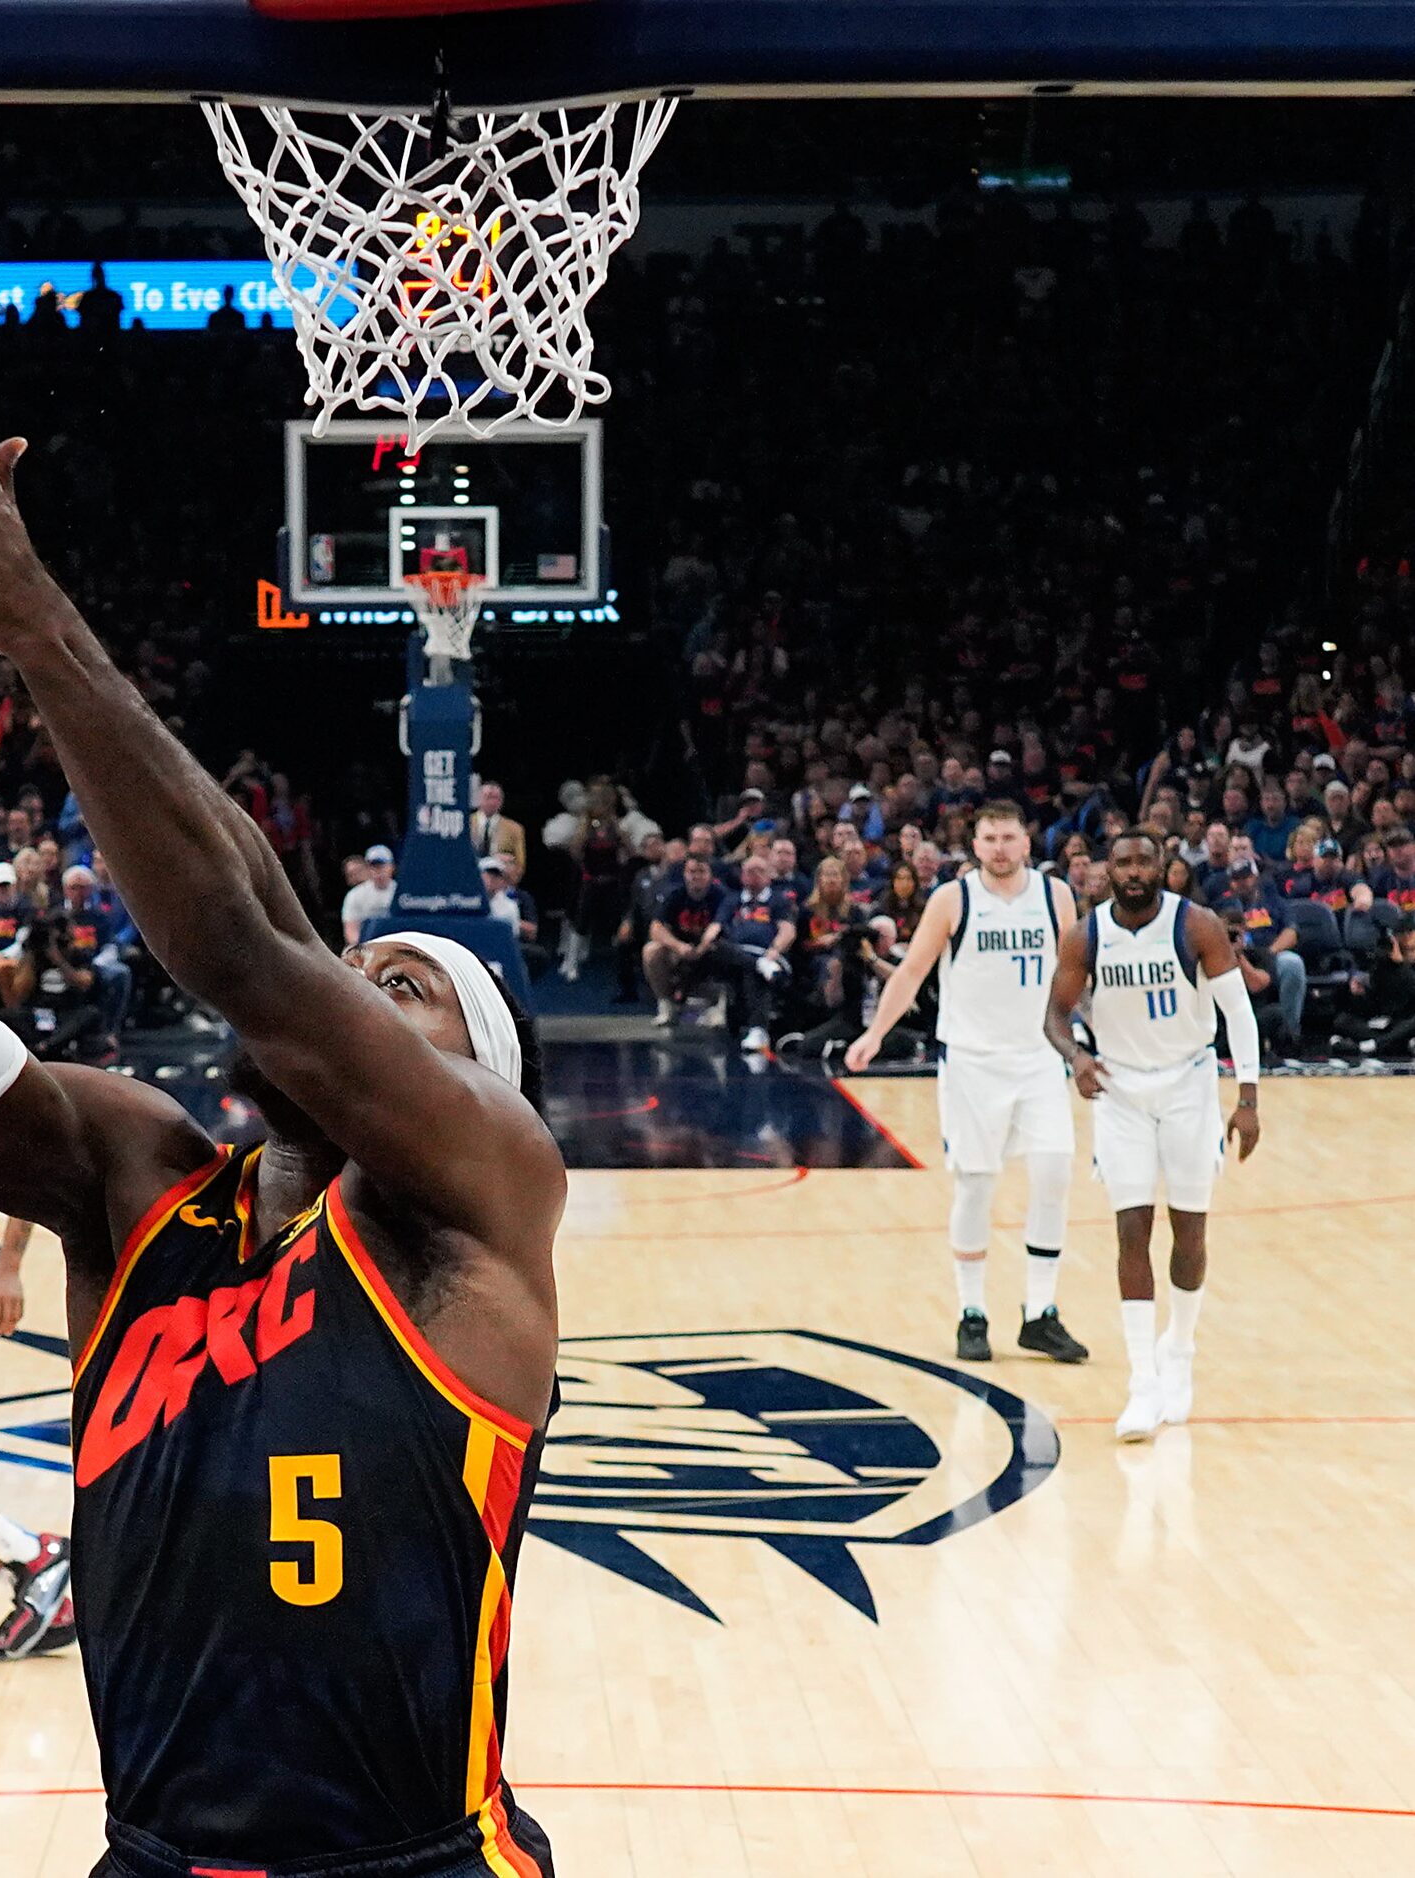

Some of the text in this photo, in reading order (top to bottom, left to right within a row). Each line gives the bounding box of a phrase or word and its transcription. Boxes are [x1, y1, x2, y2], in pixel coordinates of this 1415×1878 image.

[130, 281, 164, 312] To
[977, 929, 1044, 952] DALLAS
[1012, 955, 1043, 986] 77
[1101, 961, 1175, 987] DALLAS
[1144, 988, 1177, 1020] 10
[268, 1453, 344, 1606] 5
